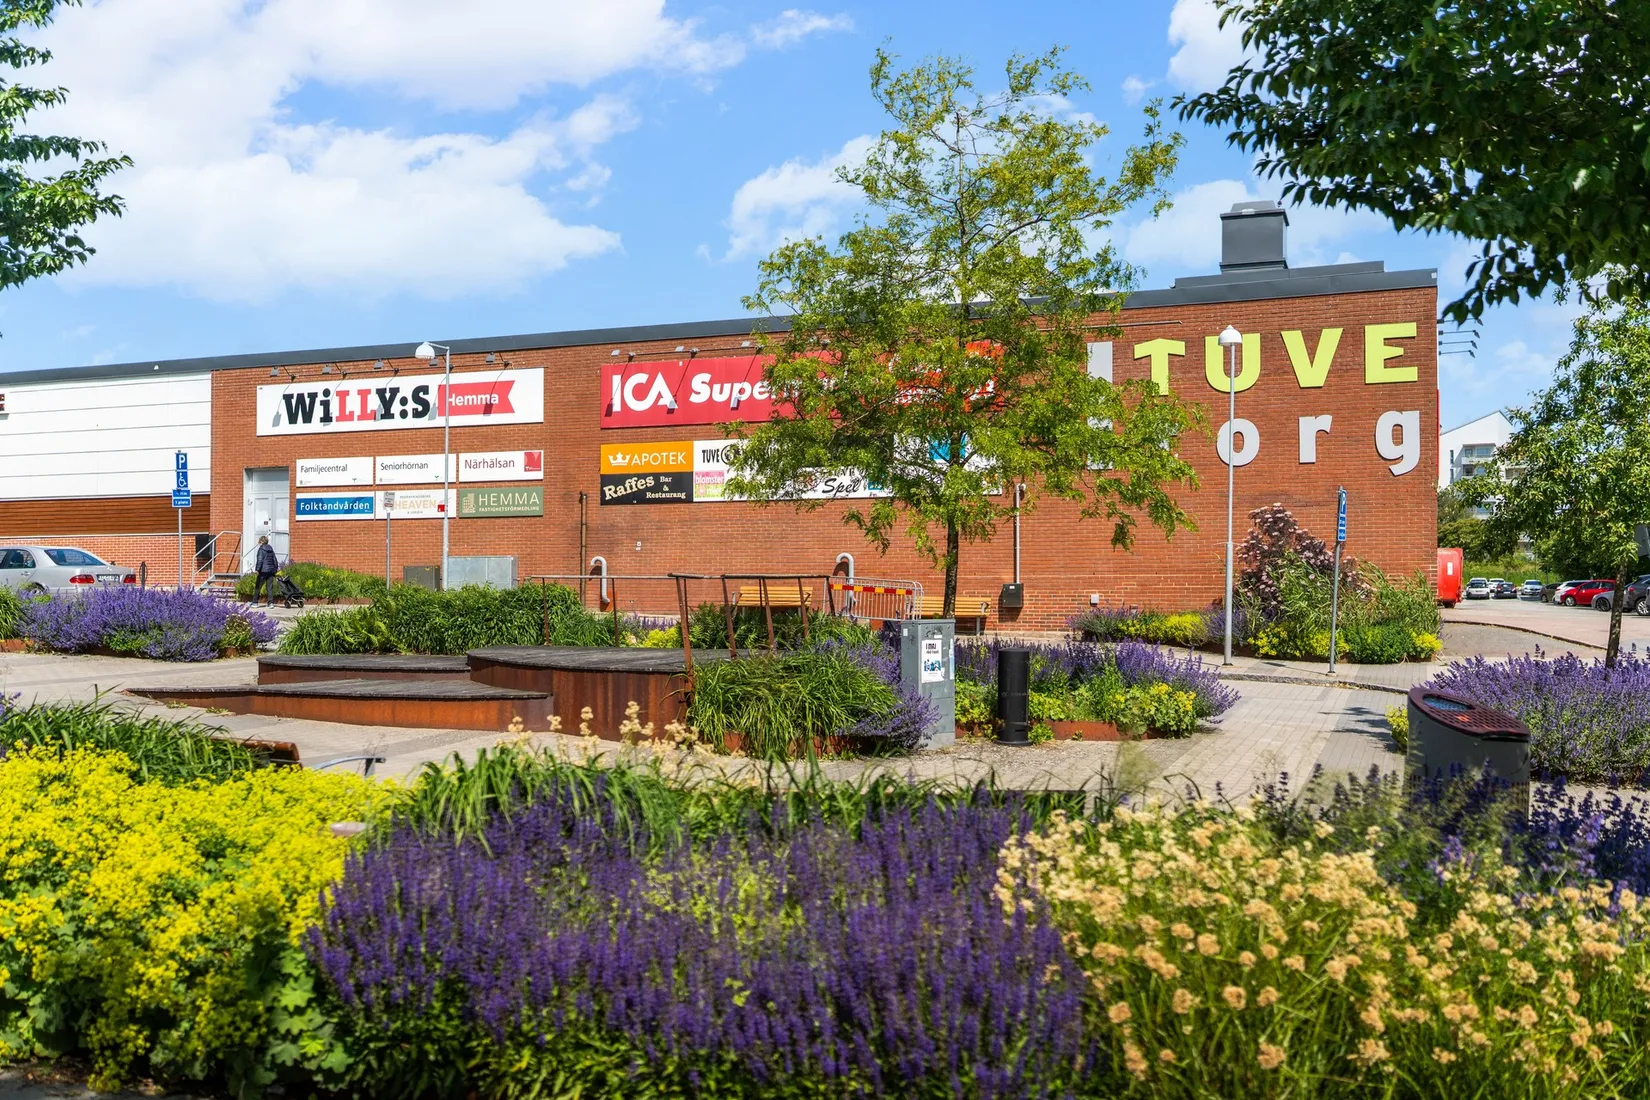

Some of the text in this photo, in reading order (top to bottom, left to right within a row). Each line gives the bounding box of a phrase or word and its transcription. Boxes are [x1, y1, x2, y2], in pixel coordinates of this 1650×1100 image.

[1134, 322, 1419, 396] TUVE
[611, 372, 679, 412] ICA
[282, 384, 431, 425] WiLLY:S
[448, 393, 499, 406] Hemma
[178, 454, 186, 468] P
[631, 451, 687, 466] APOTEK
[702, 448, 720, 463] TUVE
[300, 463, 348, 475] Familjecentral
[380, 461, 429, 471] Seniorhörnan
[464, 457, 516, 470] Närhälsan
[660, 475, 671, 483] Bar
[695, 475, 724, 483] blomster
[603, 475, 656, 500] Raffes
[822, 477, 860, 497] Spel
[479, 492, 540, 506] HEMMA
[646, 491, 686, 499] Restaurang
[300, 501, 370, 511] Folktandvården
[394, 500, 437, 510] HEAVEN
